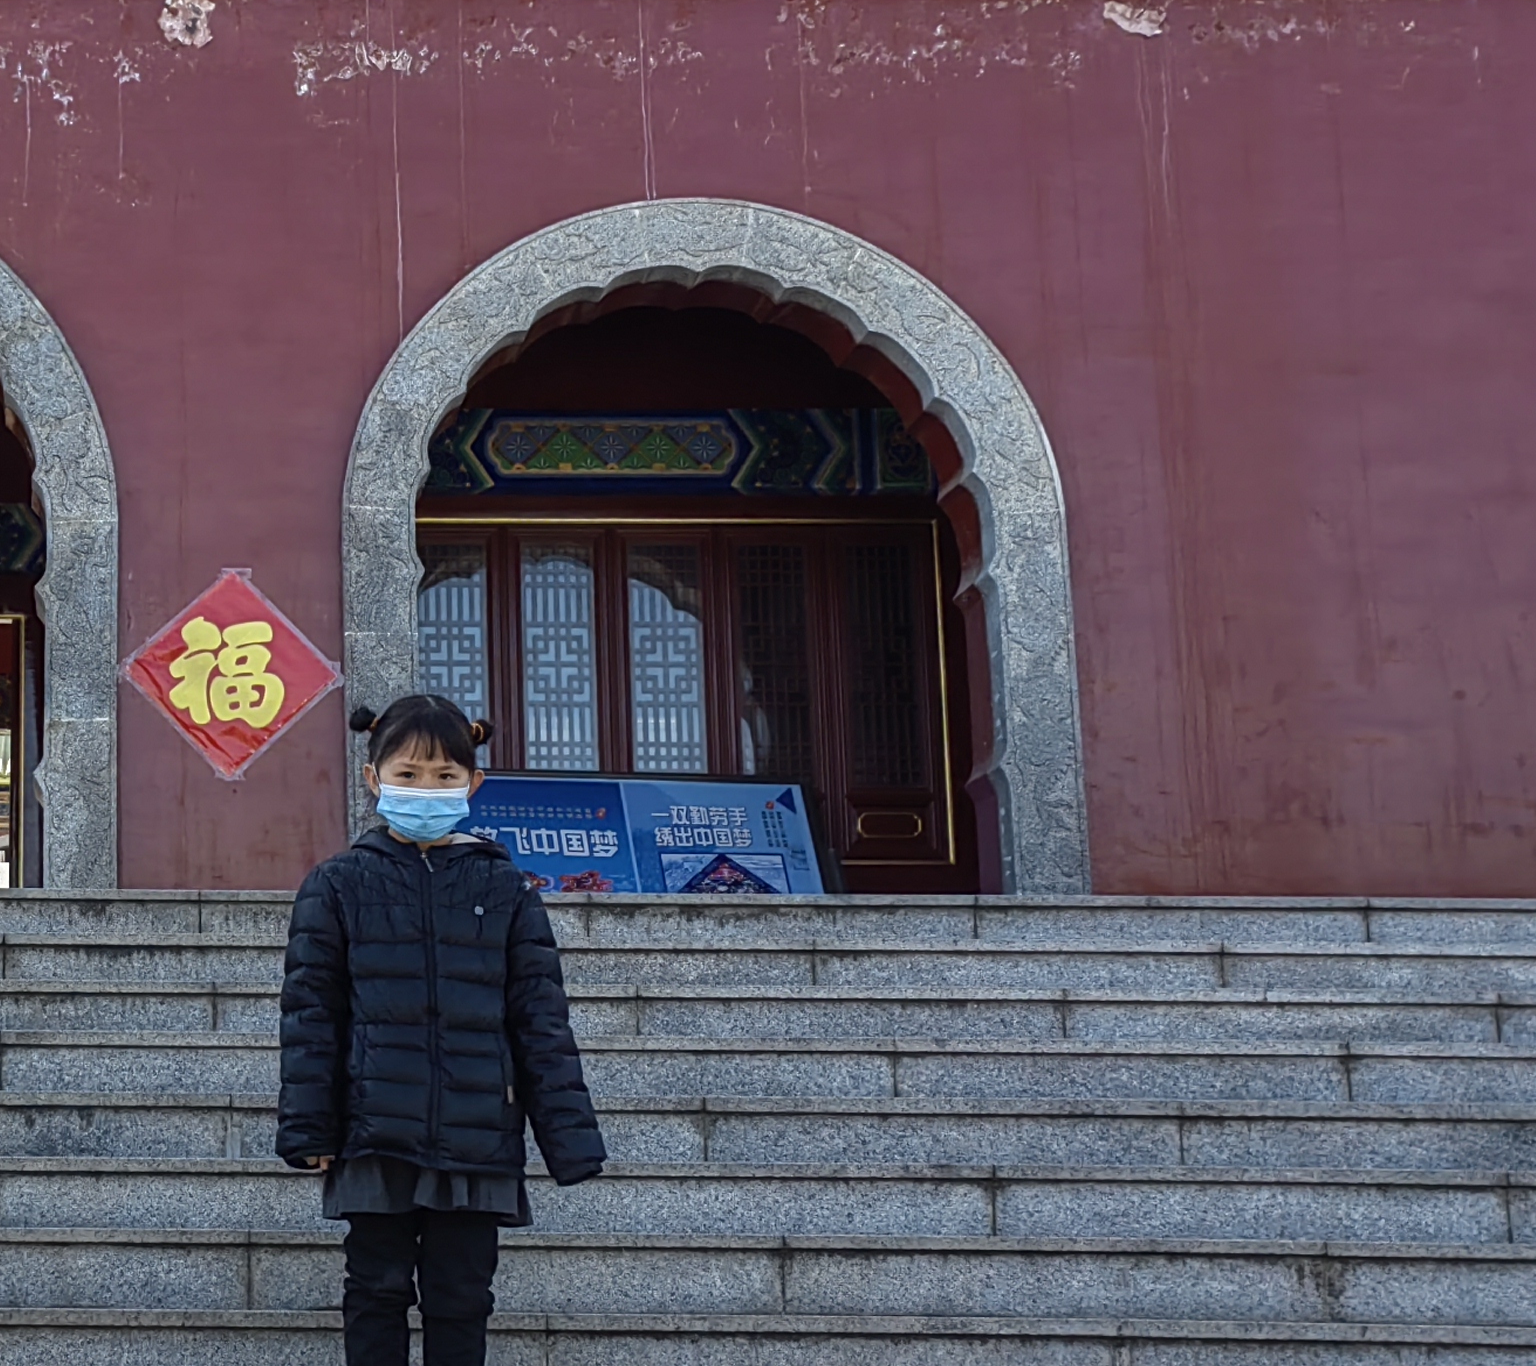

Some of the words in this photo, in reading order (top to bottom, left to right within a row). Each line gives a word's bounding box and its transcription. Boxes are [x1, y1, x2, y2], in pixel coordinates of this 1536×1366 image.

[169, 616, 285, 728] 福
[651, 805, 748, 826] 一双勤劳手
[654, 827, 753, 848] 绣出中国梦
